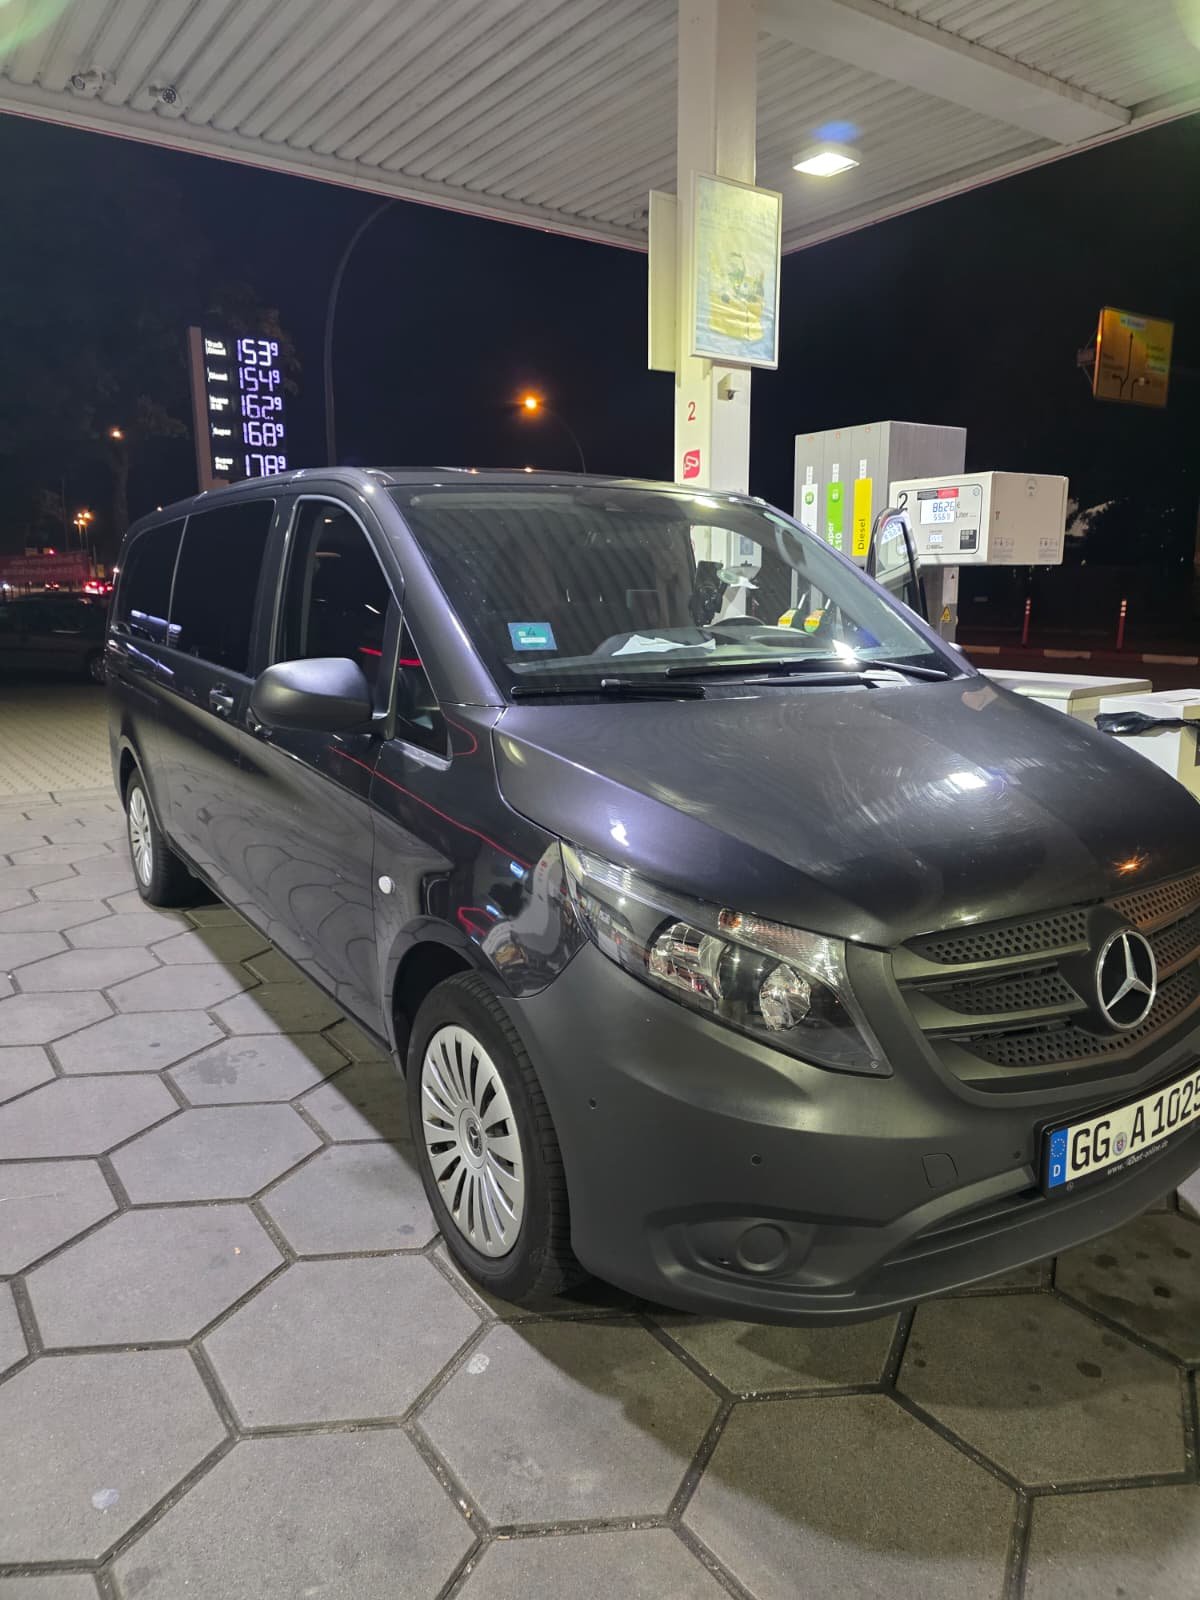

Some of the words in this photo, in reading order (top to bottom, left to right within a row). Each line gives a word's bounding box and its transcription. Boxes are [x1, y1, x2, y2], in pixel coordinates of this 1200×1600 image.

[687, 401, 696, 421] 2
[899, 492, 908, 511] 2
[857, 518, 866, 550] Diesel
[1071, 1120, 1111, 1172] GG
[1129, 1105, 1146, 1149] A
[1053, 1164, 1061, 1177] D
